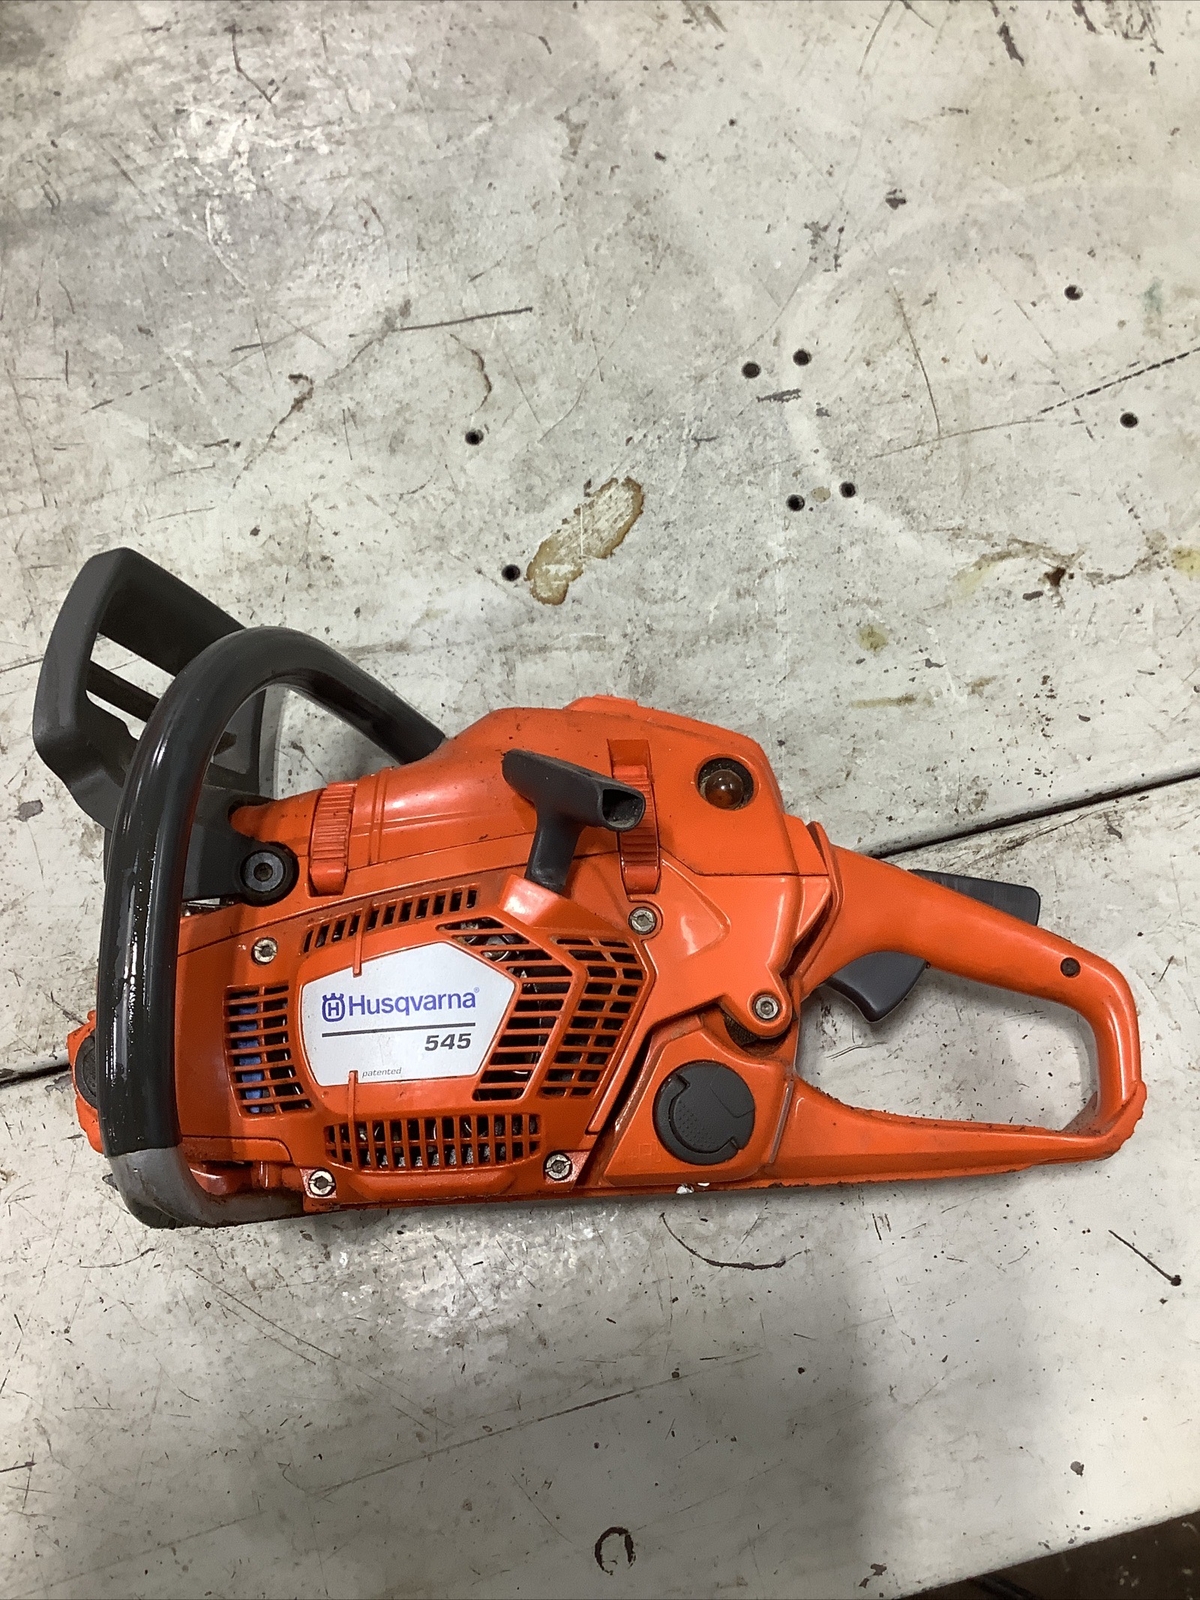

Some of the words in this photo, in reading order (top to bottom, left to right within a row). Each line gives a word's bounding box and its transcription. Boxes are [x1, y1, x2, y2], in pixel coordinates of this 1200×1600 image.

[348, 991, 477, 1017] Husqvarna
[424, 1032, 472, 1052] 545
[361, 1067, 403, 1079] patented
